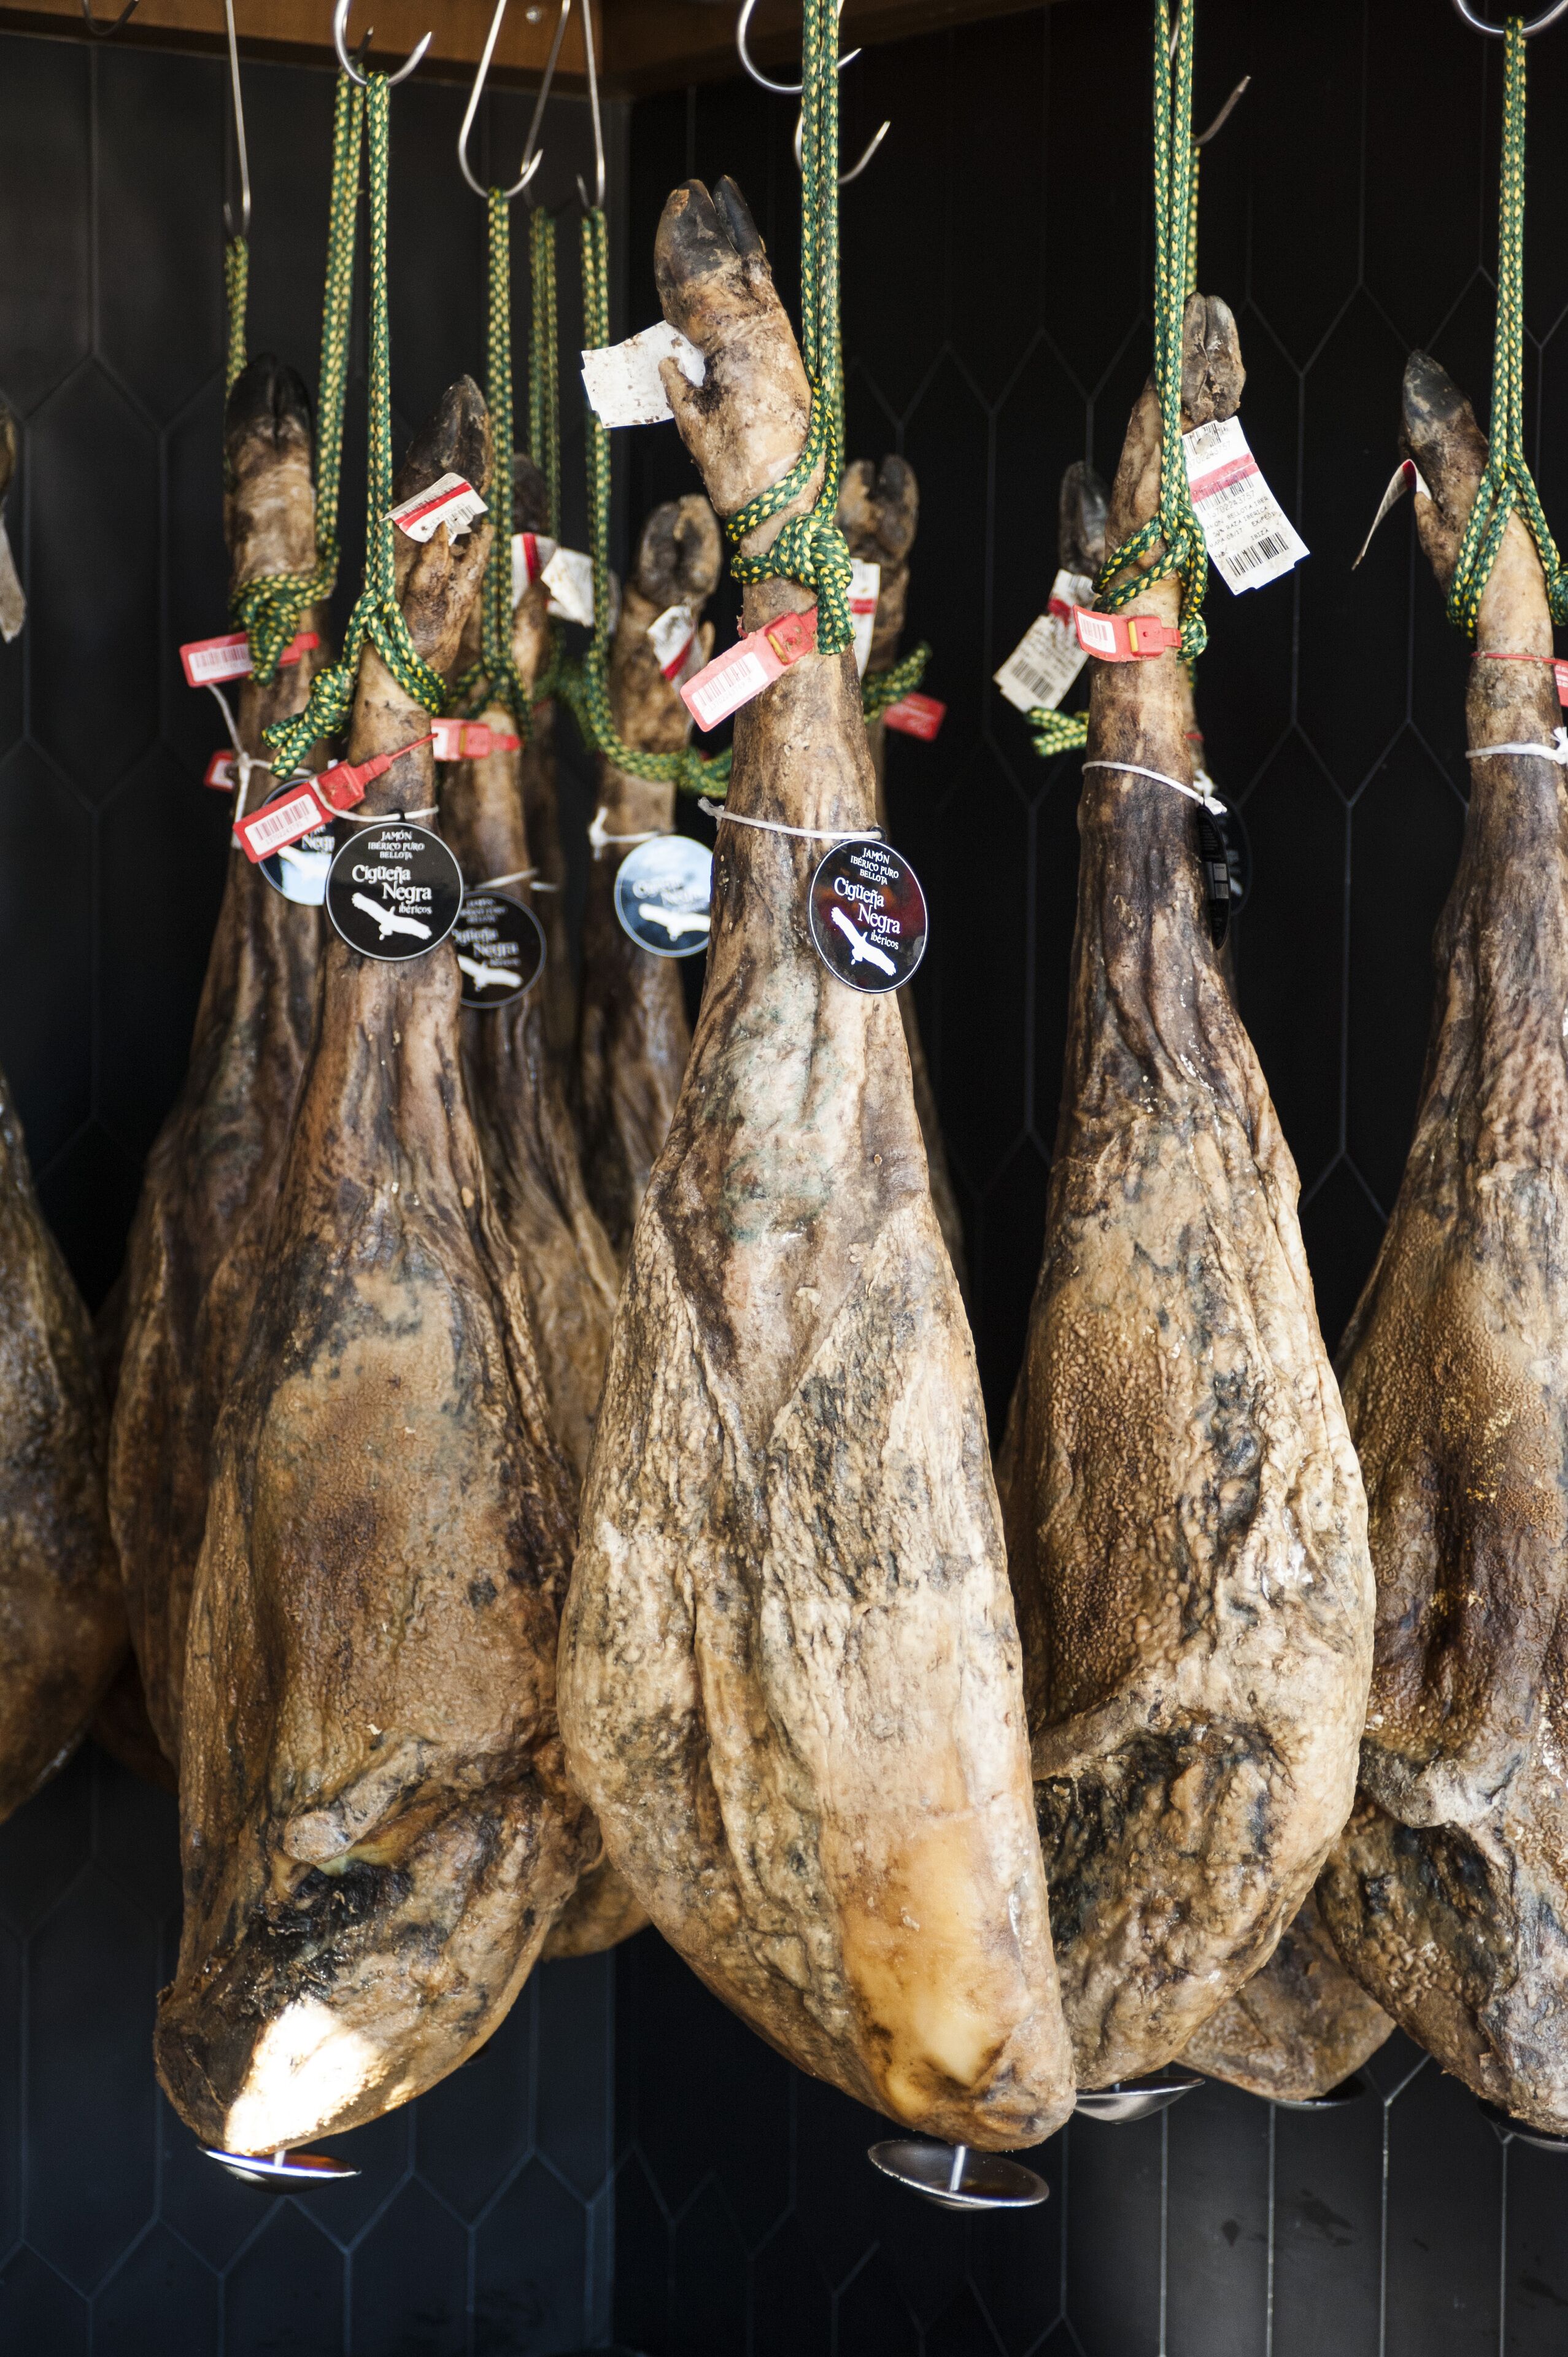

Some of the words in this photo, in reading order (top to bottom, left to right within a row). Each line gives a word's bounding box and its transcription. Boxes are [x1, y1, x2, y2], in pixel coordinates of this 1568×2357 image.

[1188, 440, 1231, 468] 3702243757
[1226, 520, 1242, 530] RAZA
[1243, 506, 1268, 522] IBERICA
[1227, 505, 1253, 520] BELLOTA
[1254, 496, 1269, 506] IBER
[1251, 528, 1269, 541] IBIZA
[381, 830, 412, 841] JAMÓN
[368, 841, 401, 851] IBÉRICO
[403, 842, 425, 851] PURO
[380, 851, 412, 860] BELLOTA
[862, 848, 890, 864] JAMÓN
[352, 864, 411, 884] Cigüeña
[850, 855, 879, 872] IBÉRICO
[880, 865, 899, 879] PURO
[860, 869, 888, 885] BELLOTA
[381, 882, 433, 904] Negra
[834, 877, 884, 910] Cigüeña
[398, 902, 433, 914] ibéricos
[857, 903, 900, 934] Negra
[870, 929, 899, 950] ibéricos
